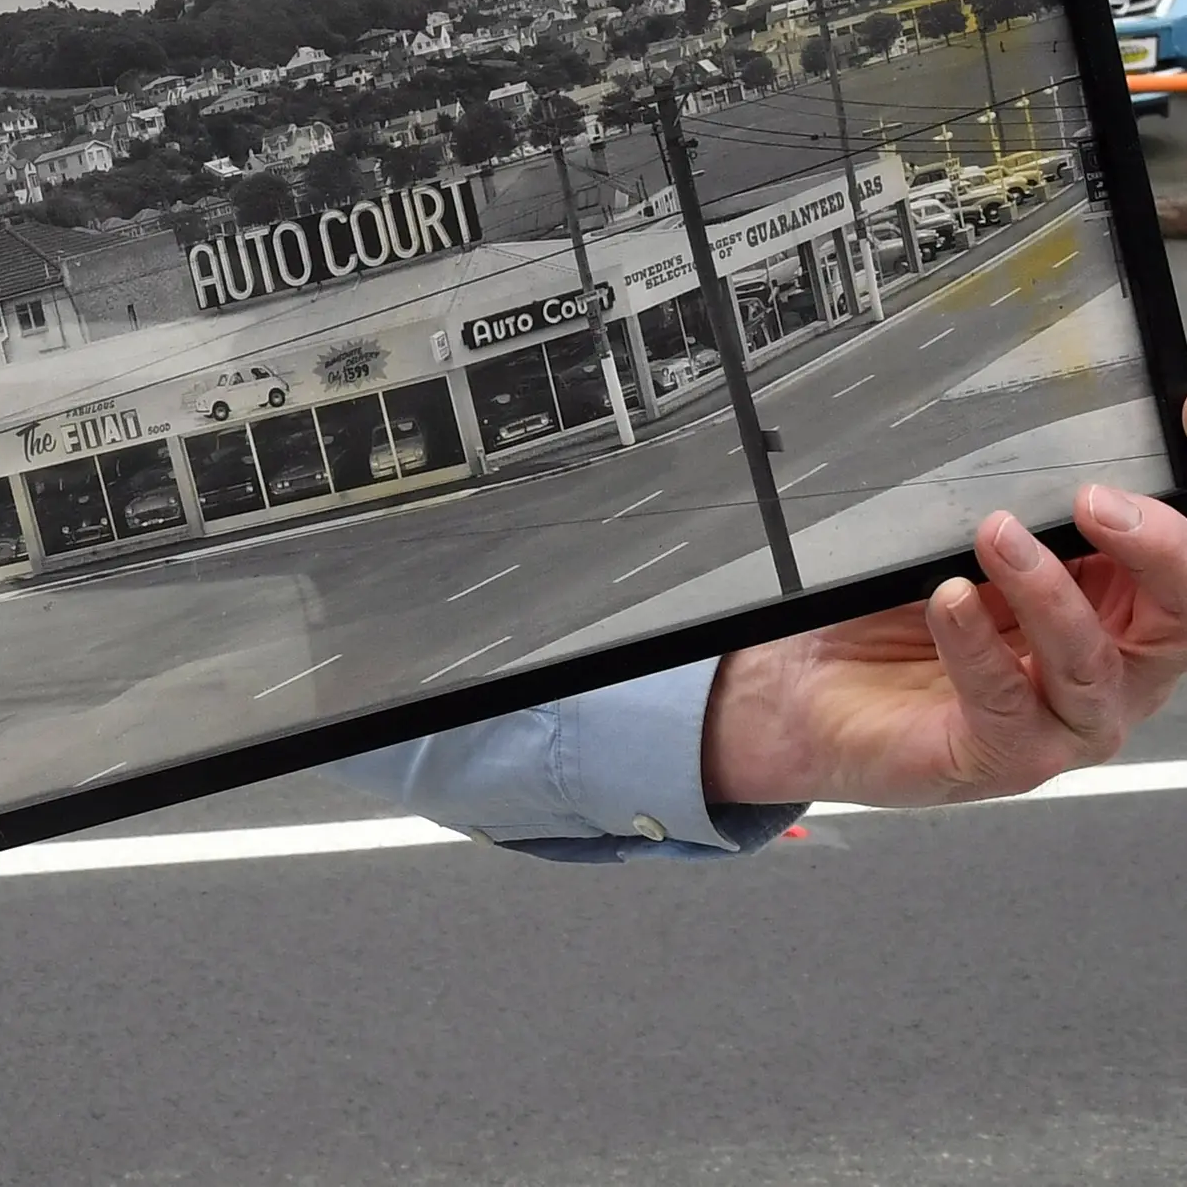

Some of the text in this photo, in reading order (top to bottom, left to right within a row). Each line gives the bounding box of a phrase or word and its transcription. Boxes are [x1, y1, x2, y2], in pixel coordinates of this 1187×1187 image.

[745, 175, 884, 247] GUARANTEED ARS
[188, 179, 474, 309] AUTO COURT
[624, 231, 743, 287] DUNEDIN'S RGEST
[718, 246, 733, 260] OF
[16, 421, 56, 463] The
[60, 409, 143, 455] FIAT
[65, 399, 116, 419] FABULOUS
